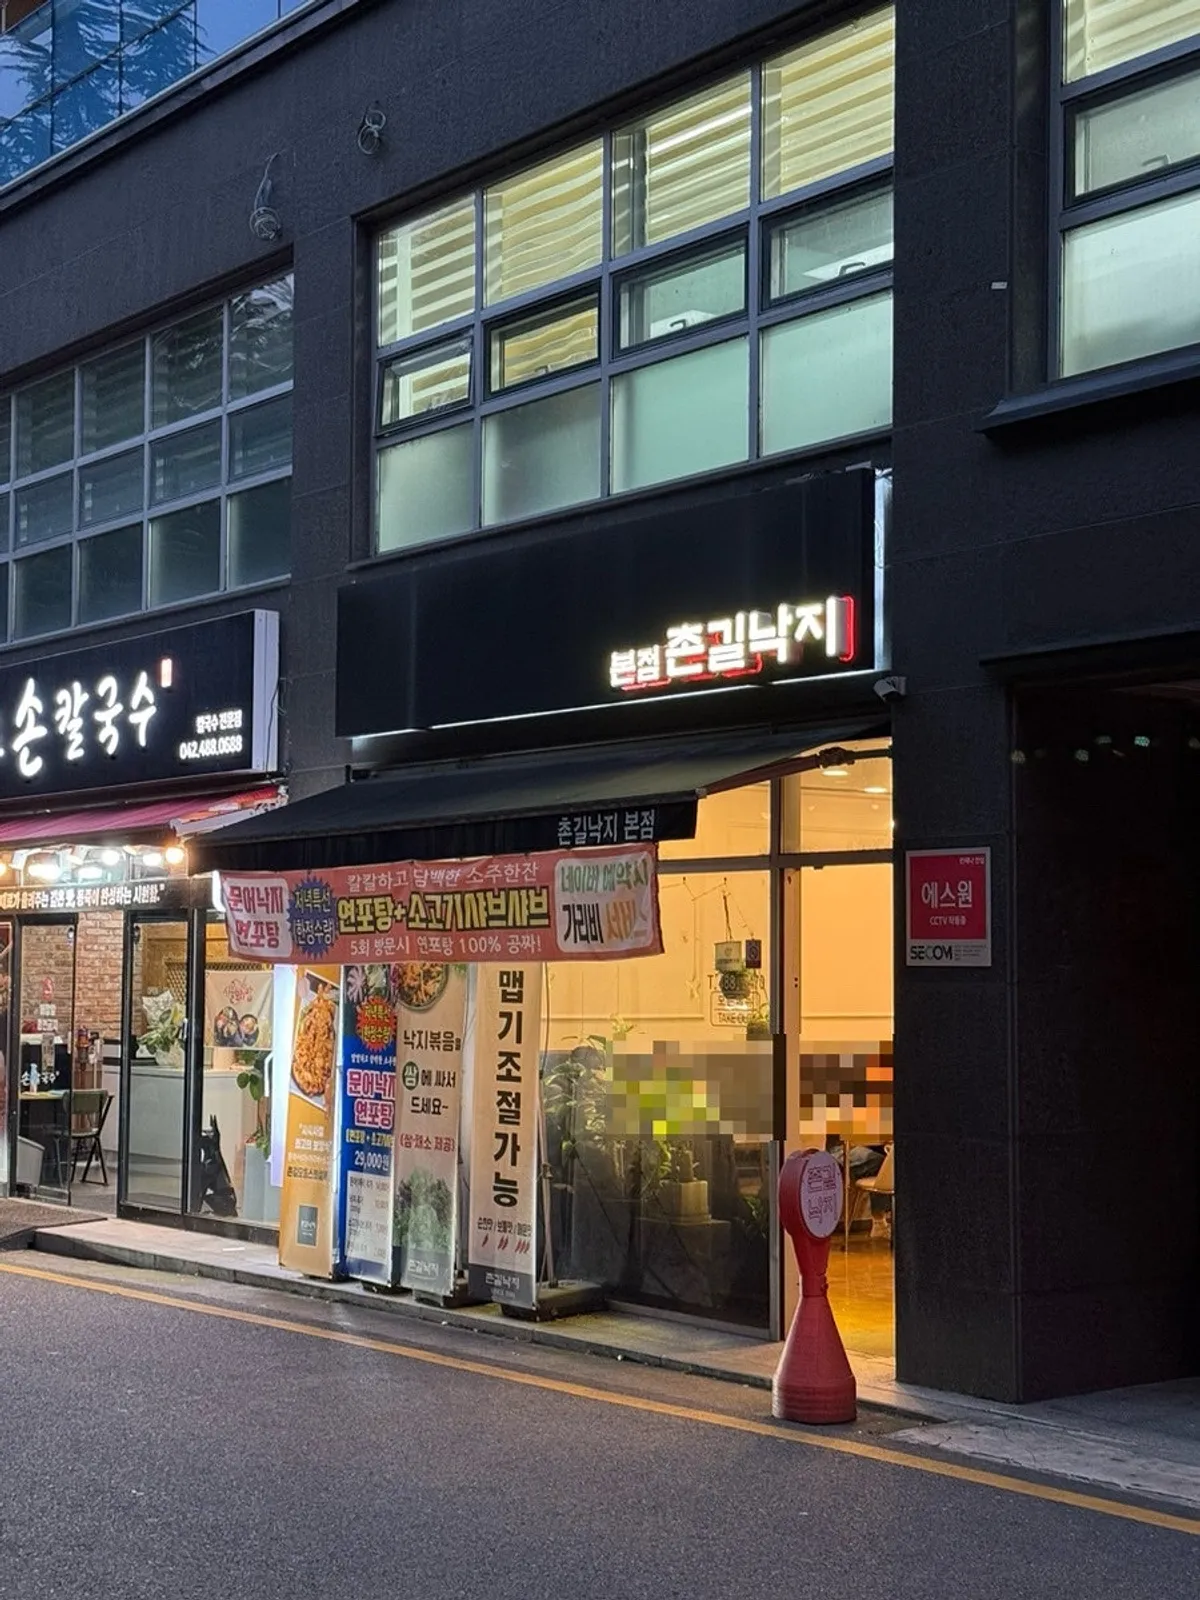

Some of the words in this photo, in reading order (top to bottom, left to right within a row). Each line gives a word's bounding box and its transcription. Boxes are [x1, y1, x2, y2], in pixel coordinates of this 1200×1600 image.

[609, 644, 661, 688] 본점
[665, 595, 843, 676] 촌길낙지
[12, 671, 157, 777] 손칼국수
[558, 814, 618, 846] 촌길낙지
[624, 809, 655, 840] 본점
[347, 870, 408, 892] 칼칼하고
[413, 868, 461, 887] 담백한
[466, 861, 540, 884] 소주한잔
[561, 864, 599, 894] 네이버
[602, 860, 648, 892] 예약시
[229, 885, 284, 915] 문어낙지
[295, 889, 331, 913] 저녁특선
[921, 880, 972, 909] 에스원
[235, 920, 280, 949] 연포탕
[293, 920, 333, 945] 한정수량
[563, 903, 604, 944] 가리비
[605, 899, 648, 940] 서비스
[929, 916, 948, 926] CCTV
[948, 915, 967, 926] 작동중
[350, 939, 370, 956] 5회
[374, 938, 410, 955] 방문시
[417, 936, 453, 955] 연포탕
[459, 937, 501, 954] 100%
[507, 935, 542, 954] 공짜!
[910, 945, 953, 961] SECOM
[435, 1070, 456, 1088] 싸서
[355, 1099, 395, 1129] 연포탕
[354, 1150, 389, 1171] 29,000원
[808, 1193, 838, 1224] 낙지
